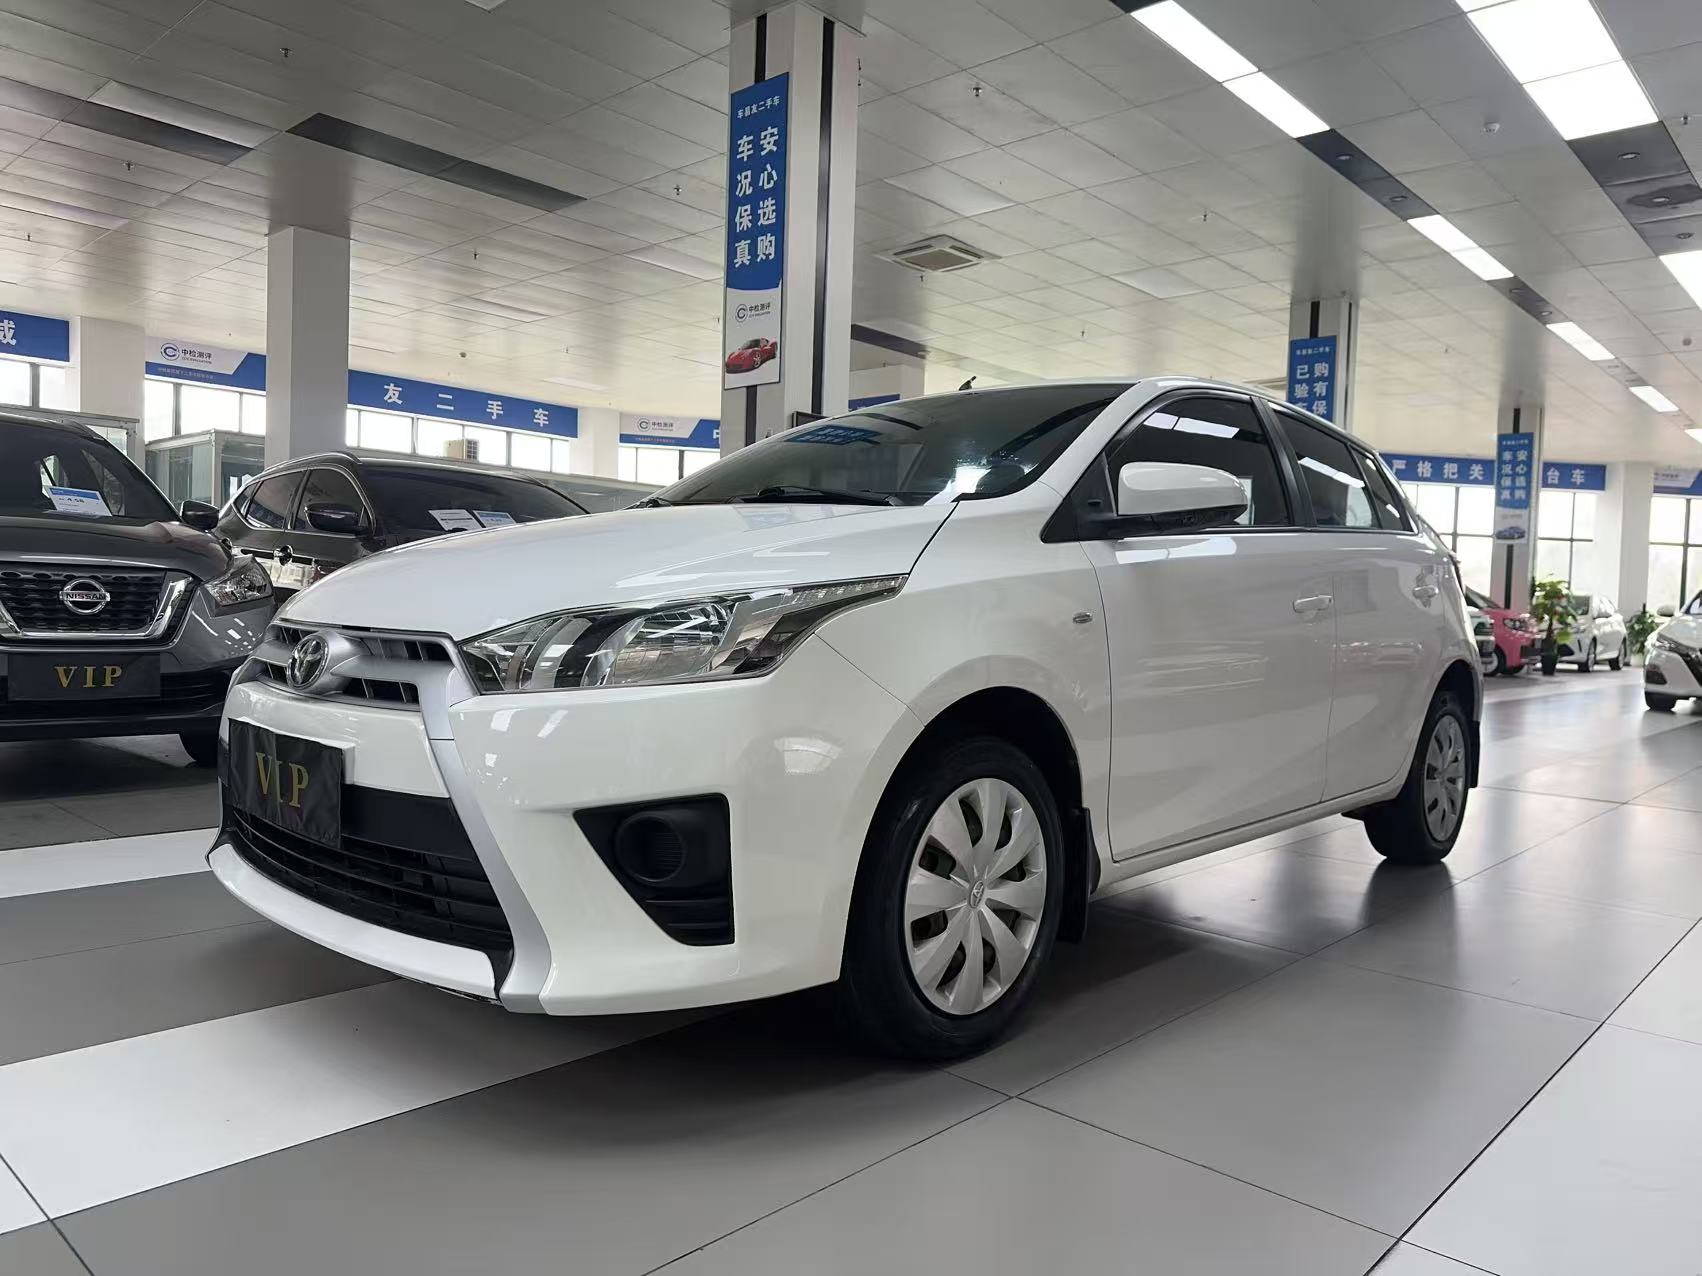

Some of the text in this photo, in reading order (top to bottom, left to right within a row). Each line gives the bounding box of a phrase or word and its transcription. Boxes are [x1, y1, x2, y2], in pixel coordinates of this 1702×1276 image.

[734, 135, 754, 268] 车况保真
[757, 126, 779, 262] 安心选购
[383, 383, 550, 427] 友二手车
[65, 592, 107, 601] NISSAN
[54, 665, 123, 688] VIP
[256, 751, 309, 808] VIP
